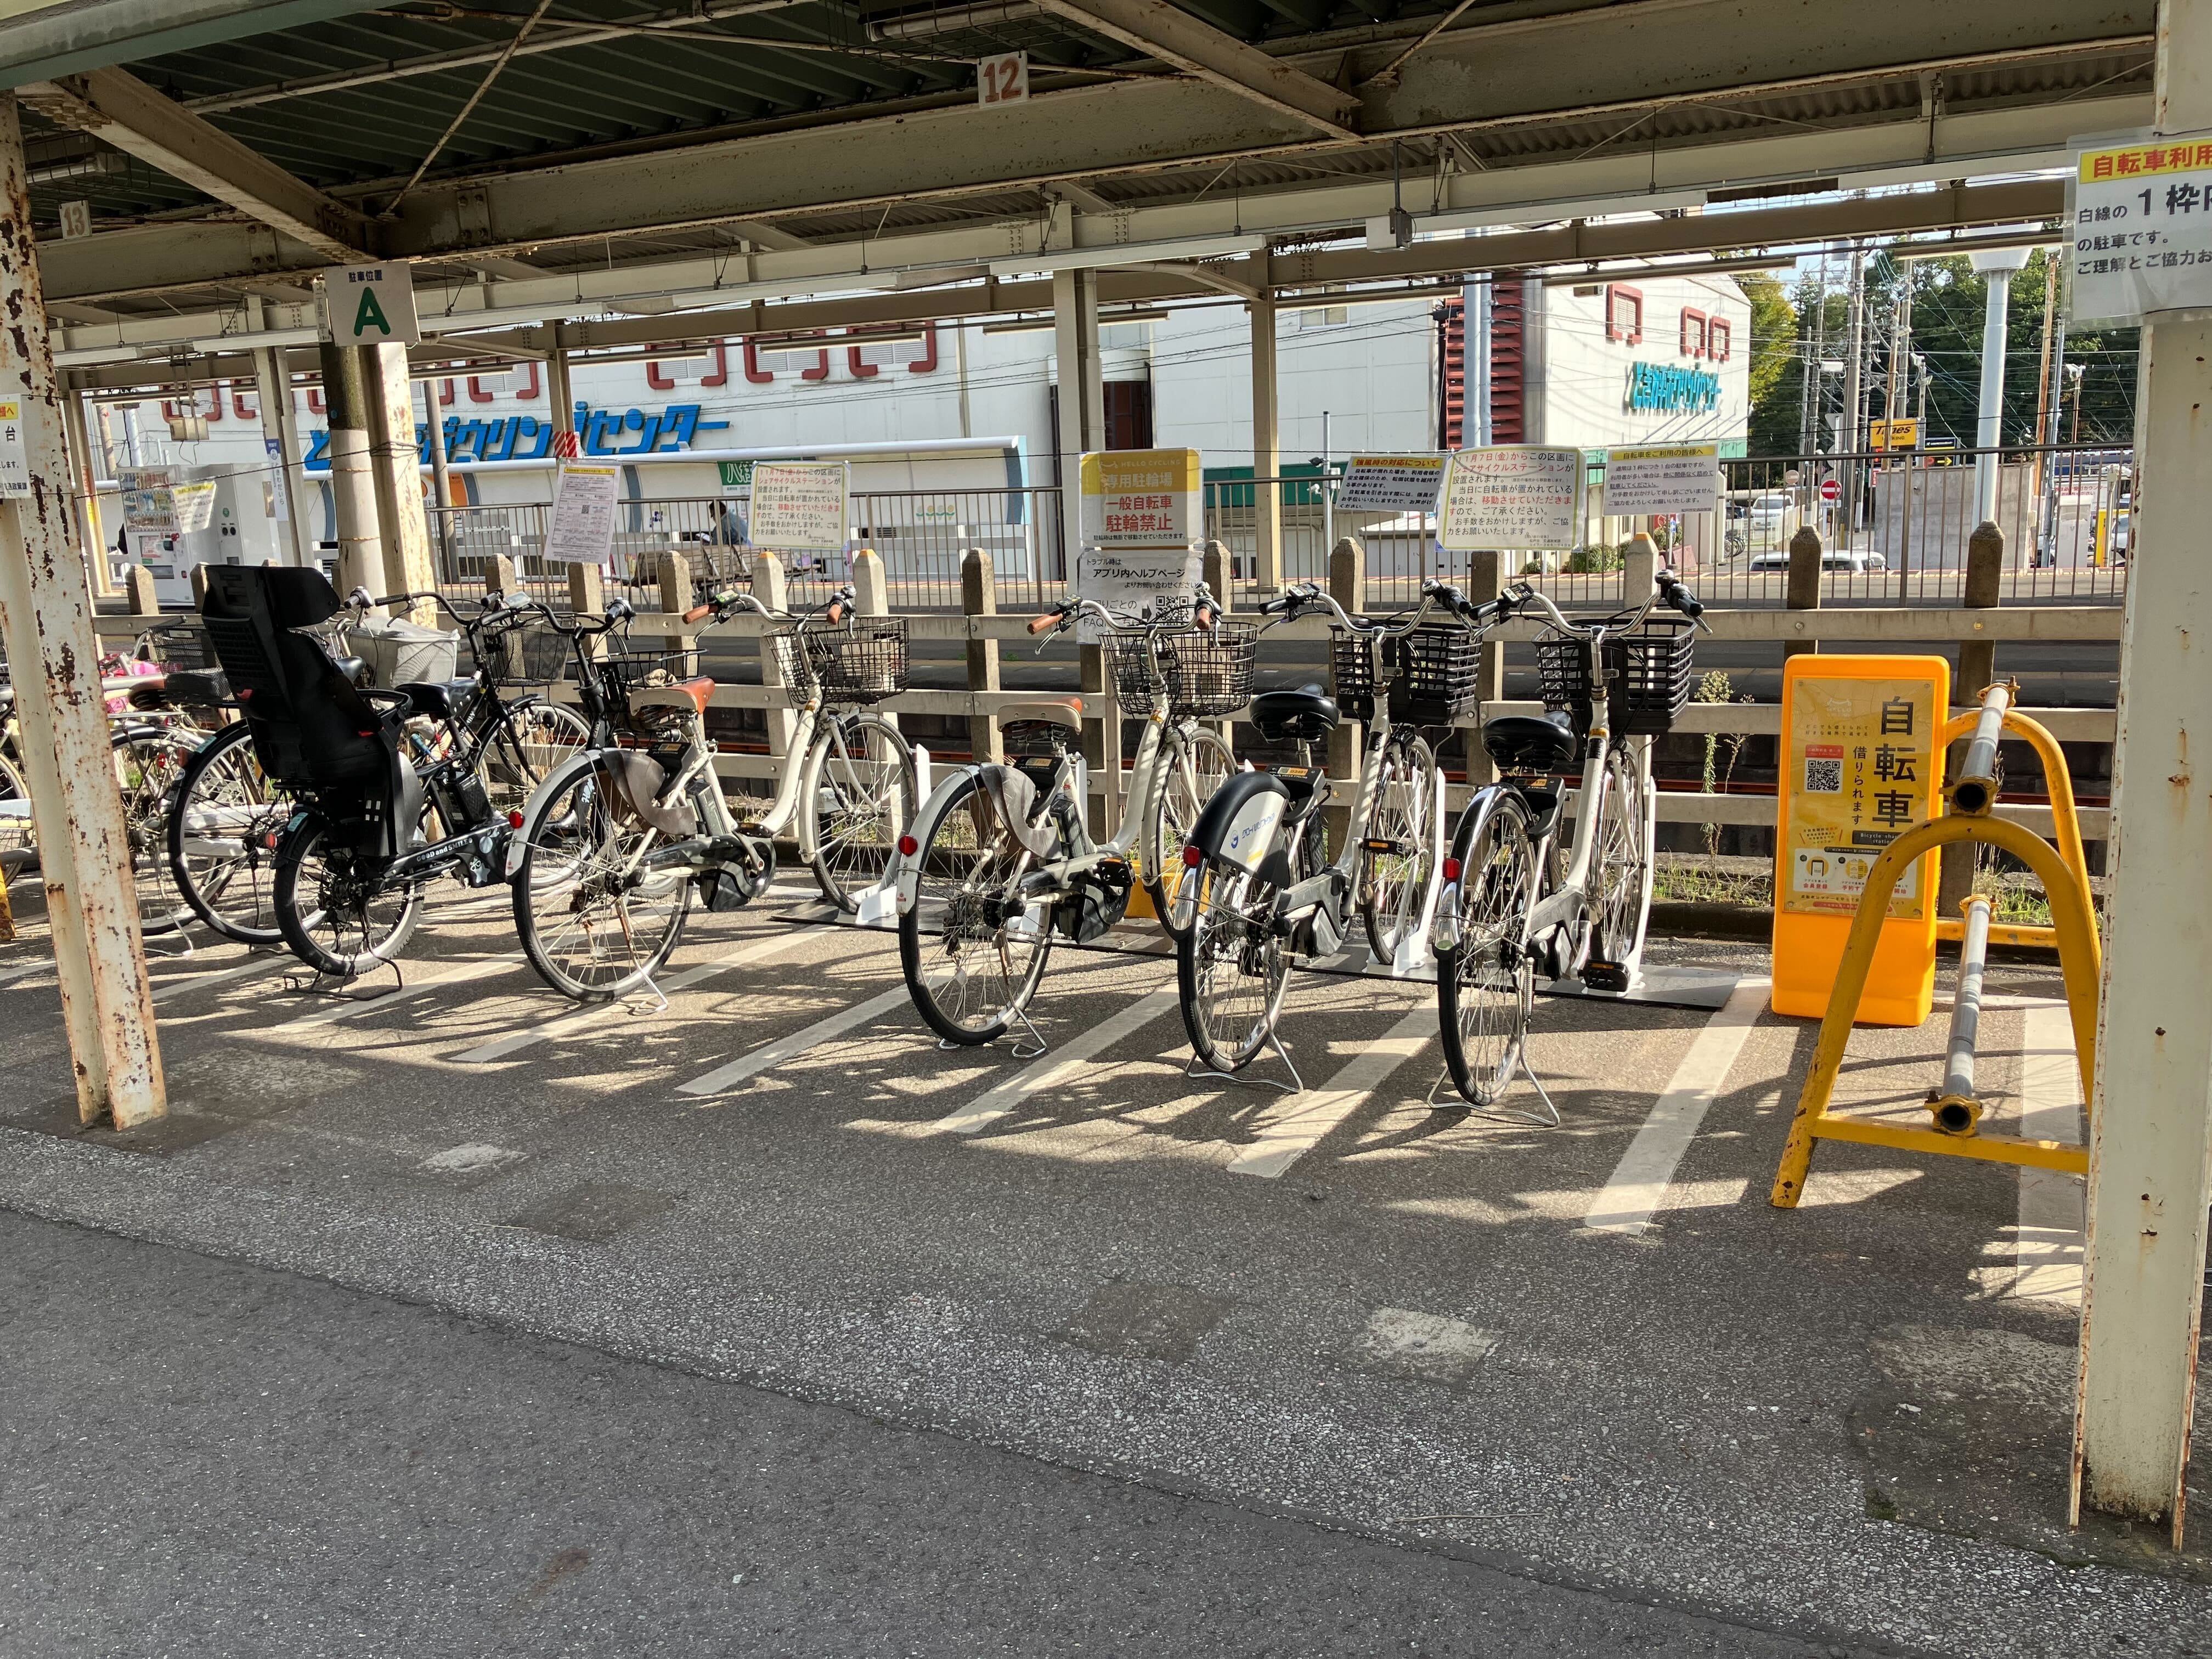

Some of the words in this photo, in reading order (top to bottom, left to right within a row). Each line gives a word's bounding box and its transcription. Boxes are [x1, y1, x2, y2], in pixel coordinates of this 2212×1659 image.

[984, 58, 1022, 103] 12
[64, 207, 84, 236] 13
[2079, 205, 2128, 224] 白線の
[2077, 230, 2168, 252] の駐車です。
[348, 269, 382, 283] 駐車位置
[354, 287, 391, 336] A
[5, 426, 15, 442] 台
[1623, 448, 1703, 459] 自転車をご利用の皆様へ
[1454, 464, 1573, 474] シェアサイクルステーションが
[1107, 472, 1172, 488] 専用駐輪場
[1452, 475, 1505, 484] 設置されます。
[1459, 485, 1572, 494] 当日に自転車が置かれている
[1106, 495, 1172, 510] 一般自転車
[1450, 496, 1572, 505] 場合は、移動させていただきま
[1449, 507, 1548, 516] すので、ご了承ください。
[1106, 513, 1173, 532] 駐輪禁止
[1455, 517, 1569, 526] お手数をおかけしますが、ご協
[1447, 527, 1530, 535] 力をお願いいたします。
[1093, 568, 1185, 578] アプリ内ヘルプページ
[1872, 696, 1917, 828] 自転車
[1852, 746, 1867, 825] 借りられます
[416, 851, 435, 862] GOOD
[436, 846, 448, 856] and
[448, 840, 469, 850] SMILE
